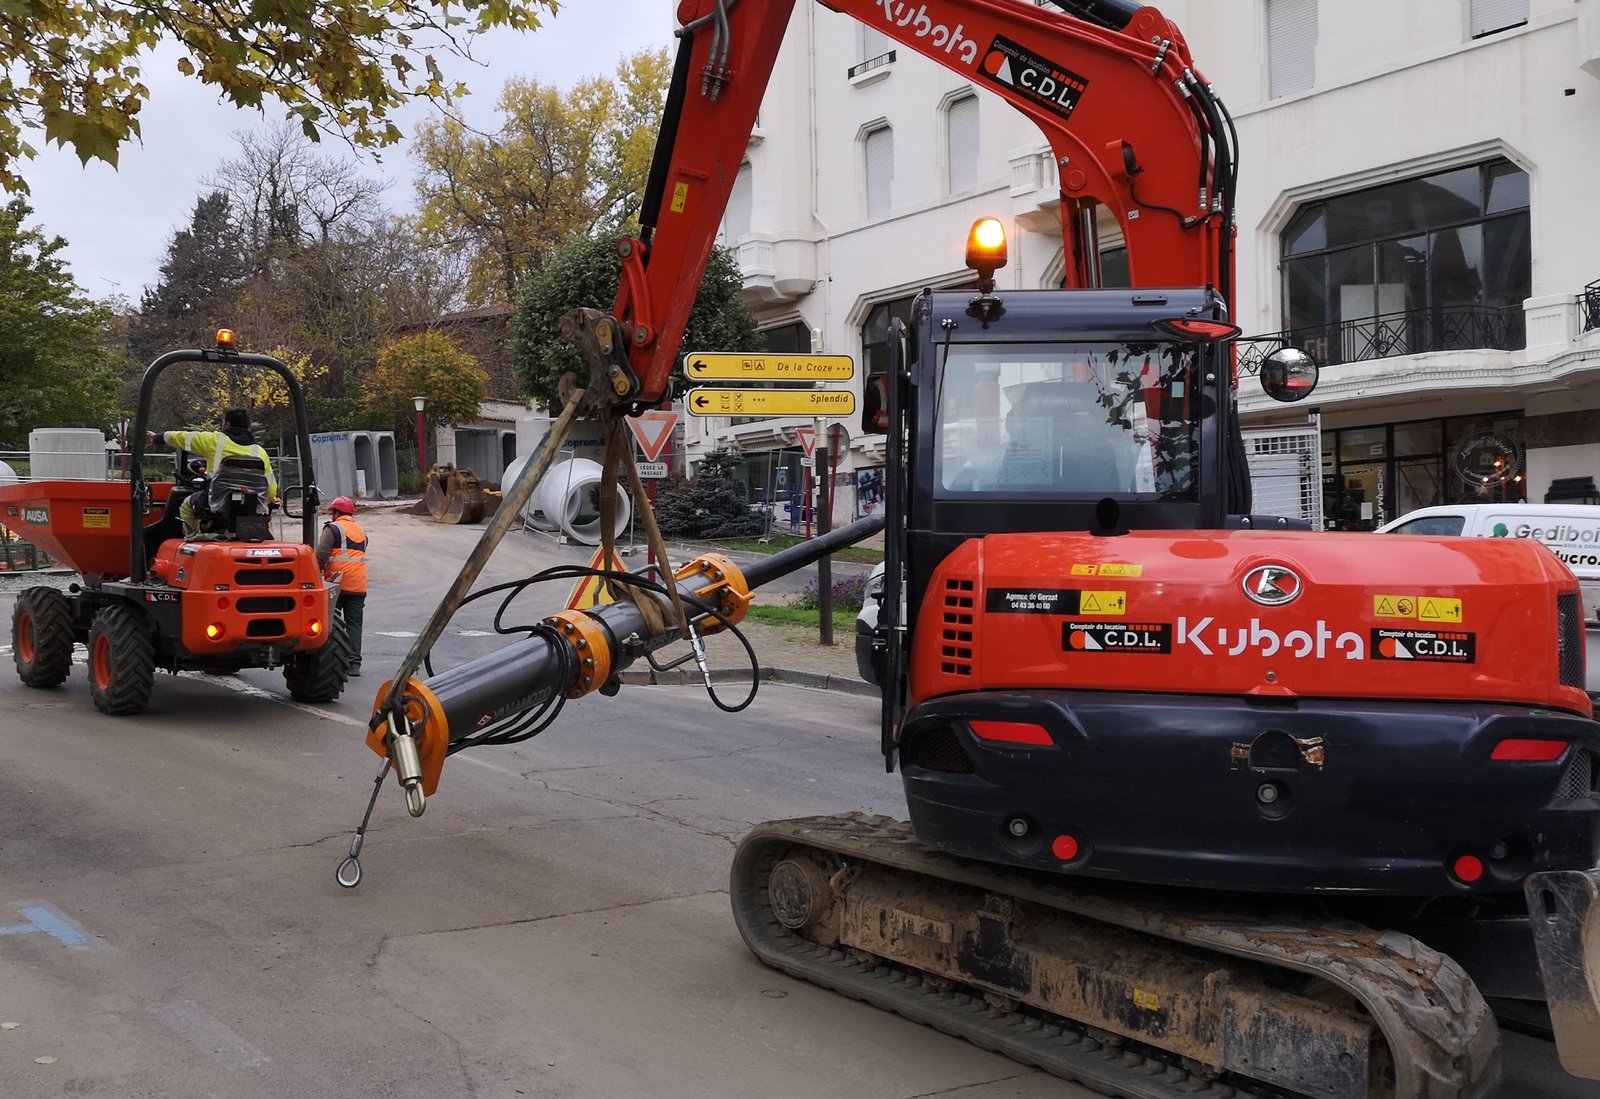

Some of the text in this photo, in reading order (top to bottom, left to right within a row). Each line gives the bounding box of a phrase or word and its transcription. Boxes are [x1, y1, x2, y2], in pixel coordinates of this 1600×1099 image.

[993, 40, 1051, 74] Comptoir de location
[1020, 68, 1073, 110] C.D.L.
[777, 362, 833, 372] De la Croze
[810, 394, 849, 404] Splendid
[26, 510, 48, 522] AUSA
[1006, 592, 1028, 601] Agence
[1037, 593, 1058, 601] Gerzat
[1069, 623, 1095, 631] Comptoir
[1104, 631, 1161, 647] C.D.L.
[1177, 616, 1364, 660] Kubota
[1379, 630, 1406, 638] Comptoir
[1415, 639, 1467, 656] C.D.L.
